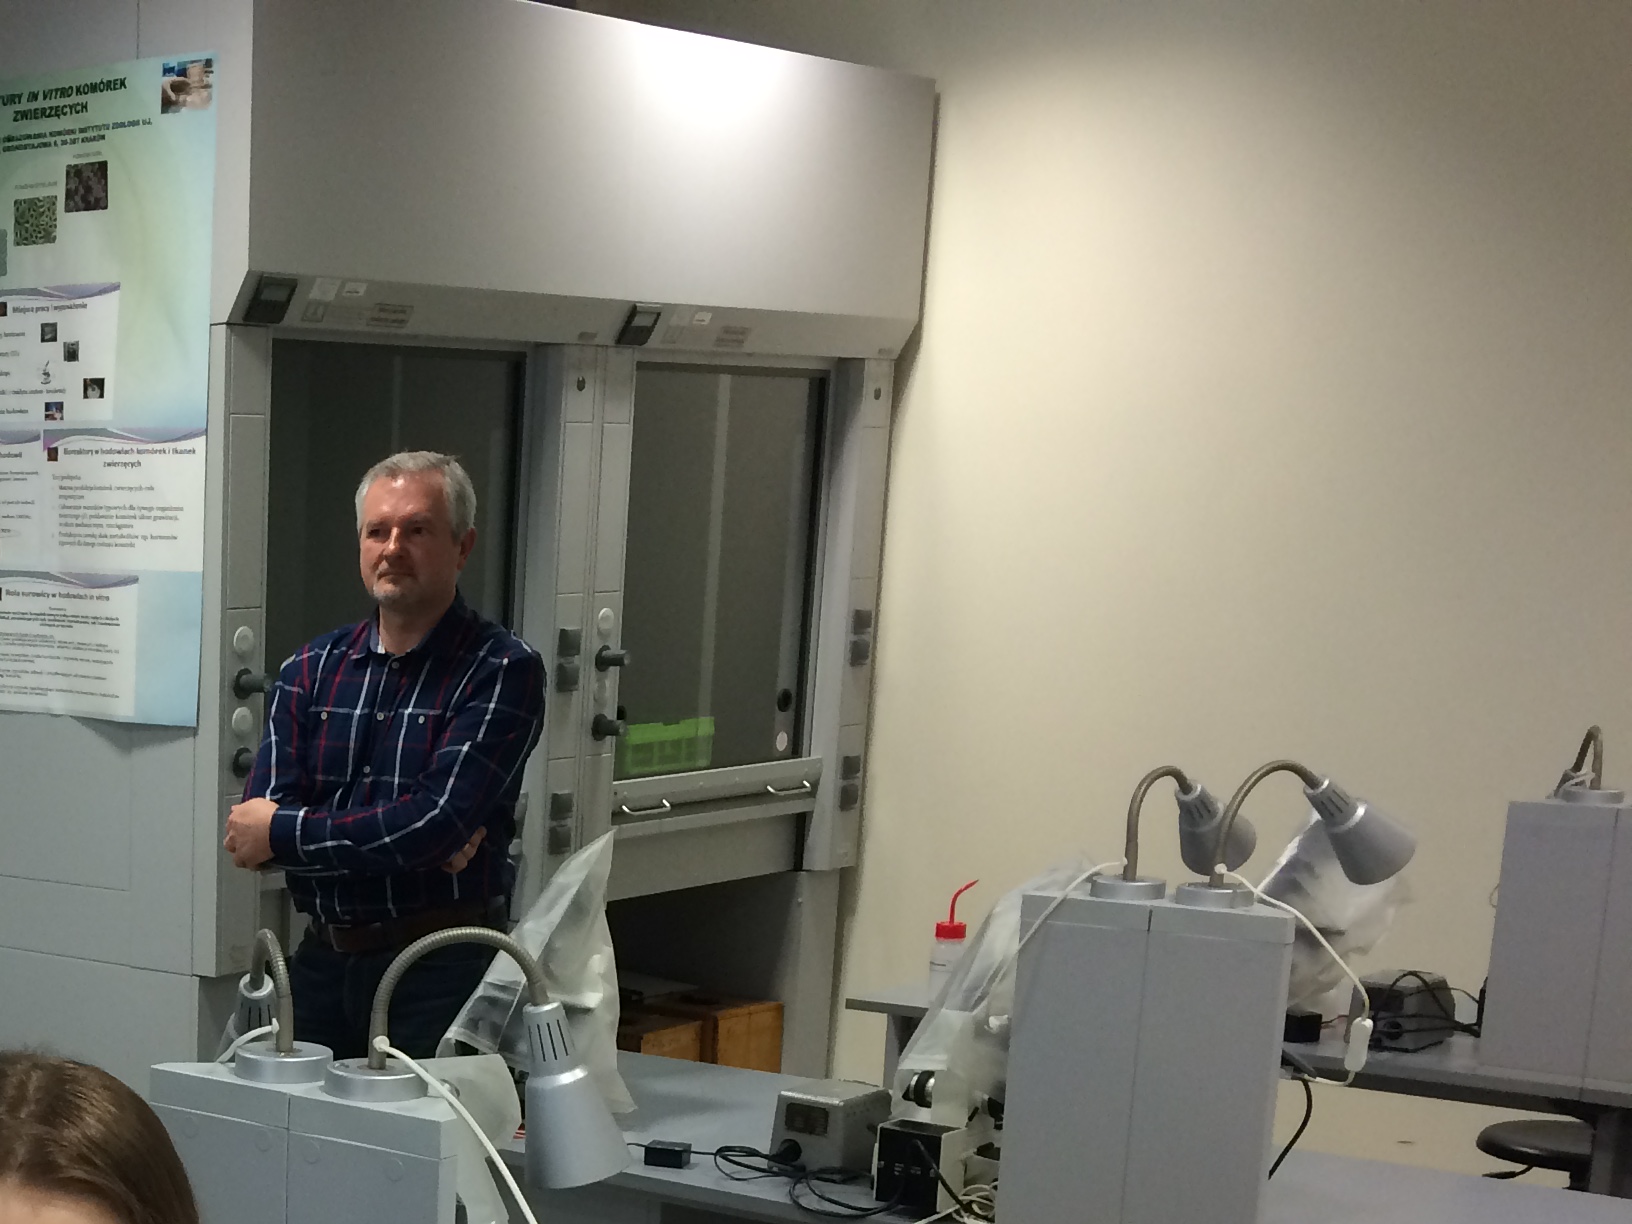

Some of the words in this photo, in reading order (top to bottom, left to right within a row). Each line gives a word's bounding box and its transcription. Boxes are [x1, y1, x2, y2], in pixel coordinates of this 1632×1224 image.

[26, 90, 39, 103] IN
[42, 85, 73, 102] VITRO
[75, 77, 127, 97] KOMÓREK
[12, 101, 88, 122] ZWIERZĘCYCH
